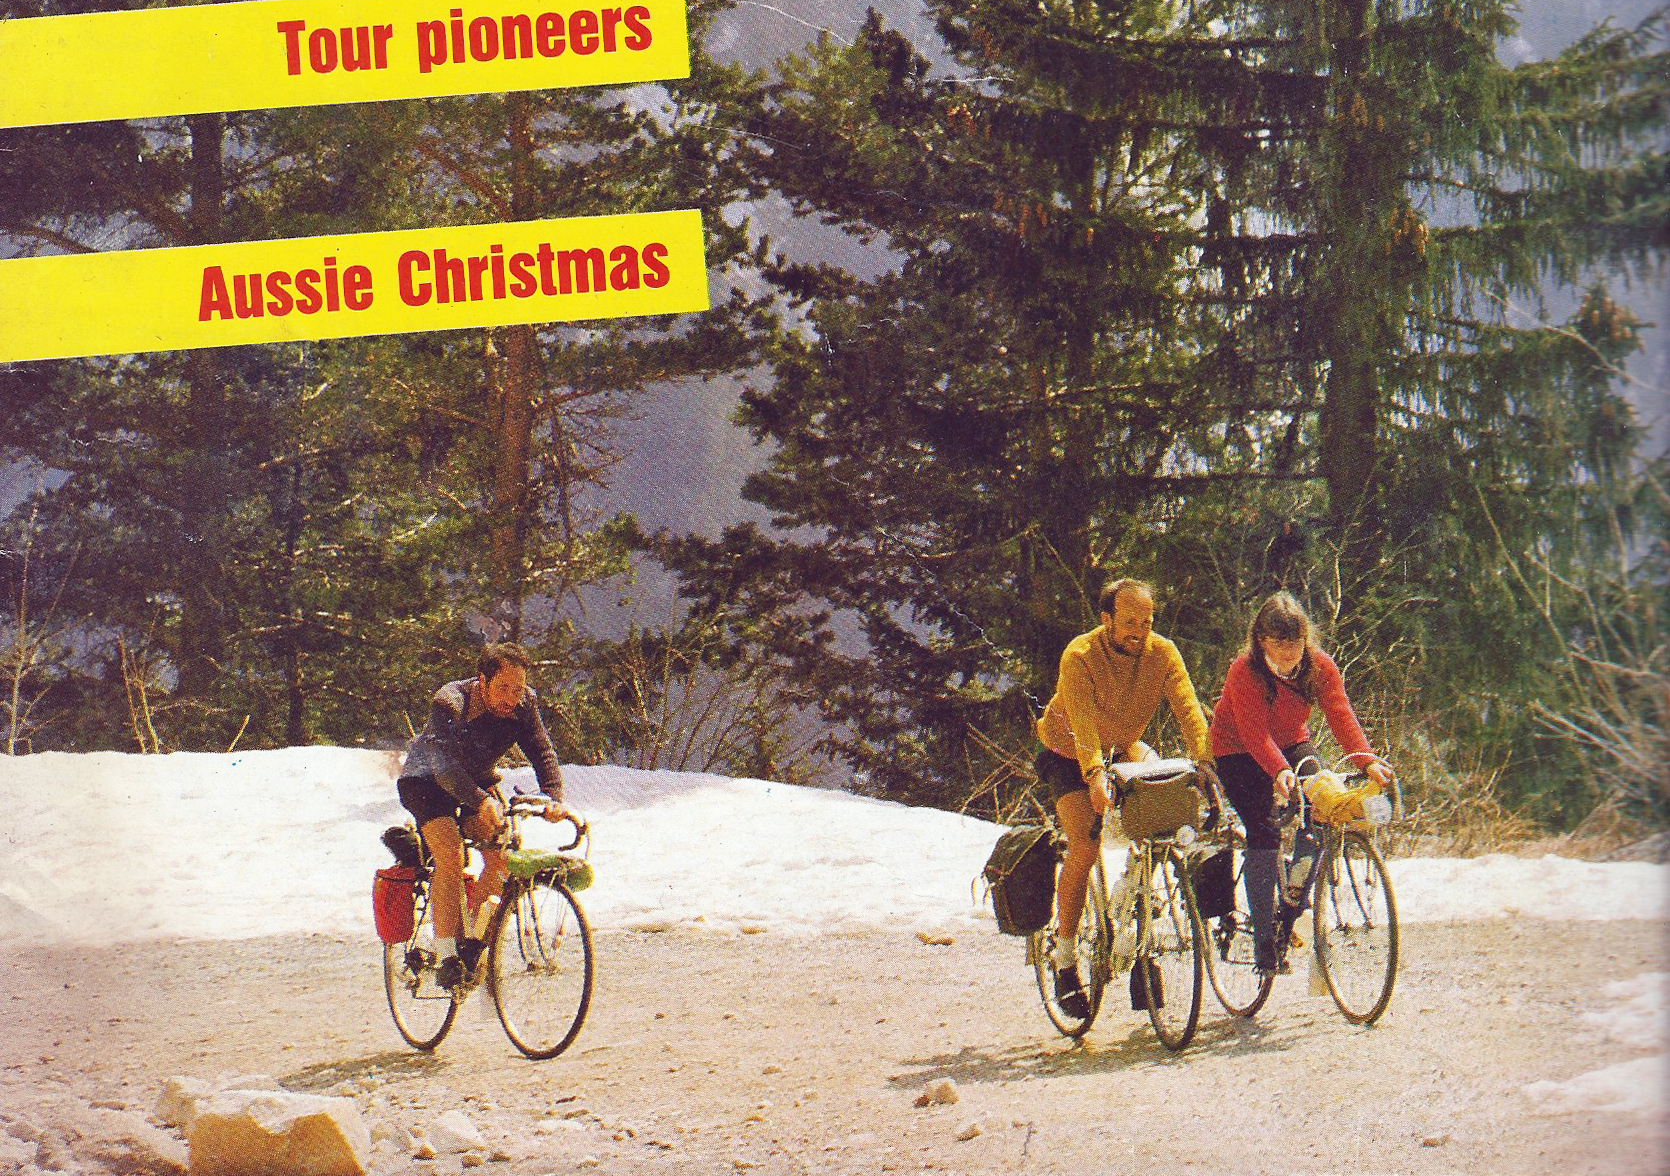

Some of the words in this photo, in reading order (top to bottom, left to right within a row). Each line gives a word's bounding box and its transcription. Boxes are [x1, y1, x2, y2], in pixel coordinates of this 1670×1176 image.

[277, 19, 393, 76] Tour
[417, 4, 653, 74] pioneers
[198, 257, 374, 322] Aussie
[397, 241, 671, 307] Christmas
